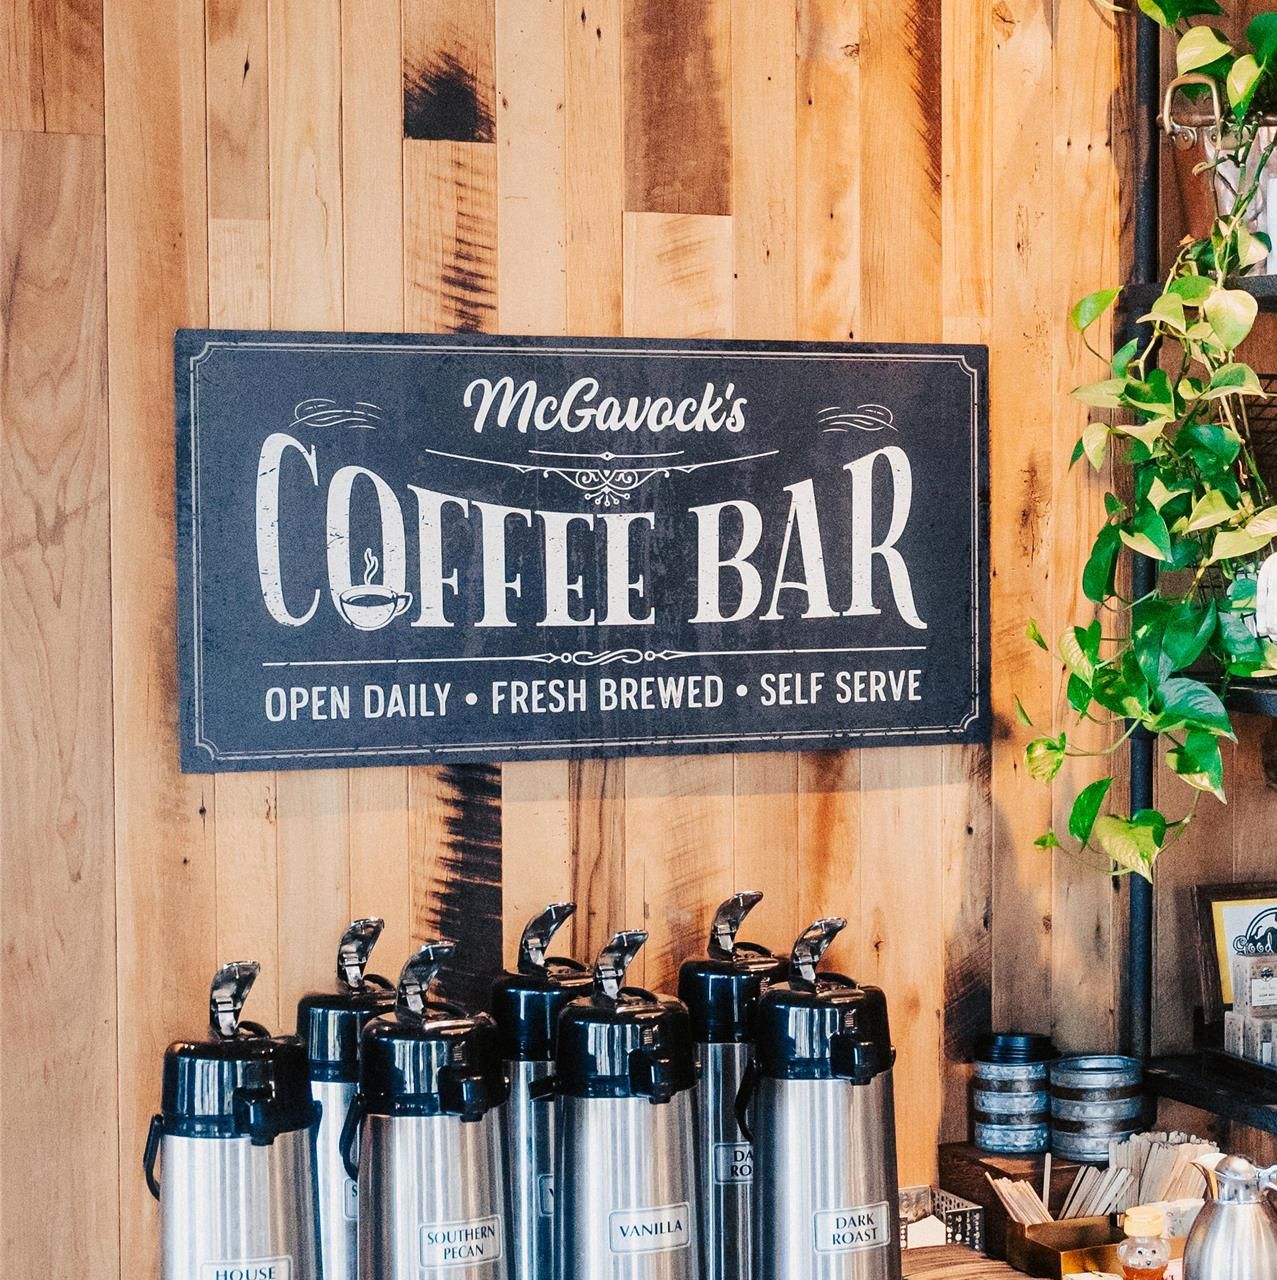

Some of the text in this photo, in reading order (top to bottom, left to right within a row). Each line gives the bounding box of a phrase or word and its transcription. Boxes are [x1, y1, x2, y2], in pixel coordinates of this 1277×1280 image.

[463, 376, 748, 433] McGavock's
[255, 431, 929, 632] COFFEE BAR
[264, 668, 922, 723] OPEN DAILY FRESH BREWED SELF SERVE
[1233, 932, 1274, 954] Good
[733, 1149, 753, 1163] DA
[618, 1219, 683, 1238] VANILLA
[836, 1212, 874, 1229] DARK
[426, 1224, 495, 1246] SOUTHERN
[832, 1227, 878, 1245] ROAST
[443, 1244, 484, 1261] PECAN
